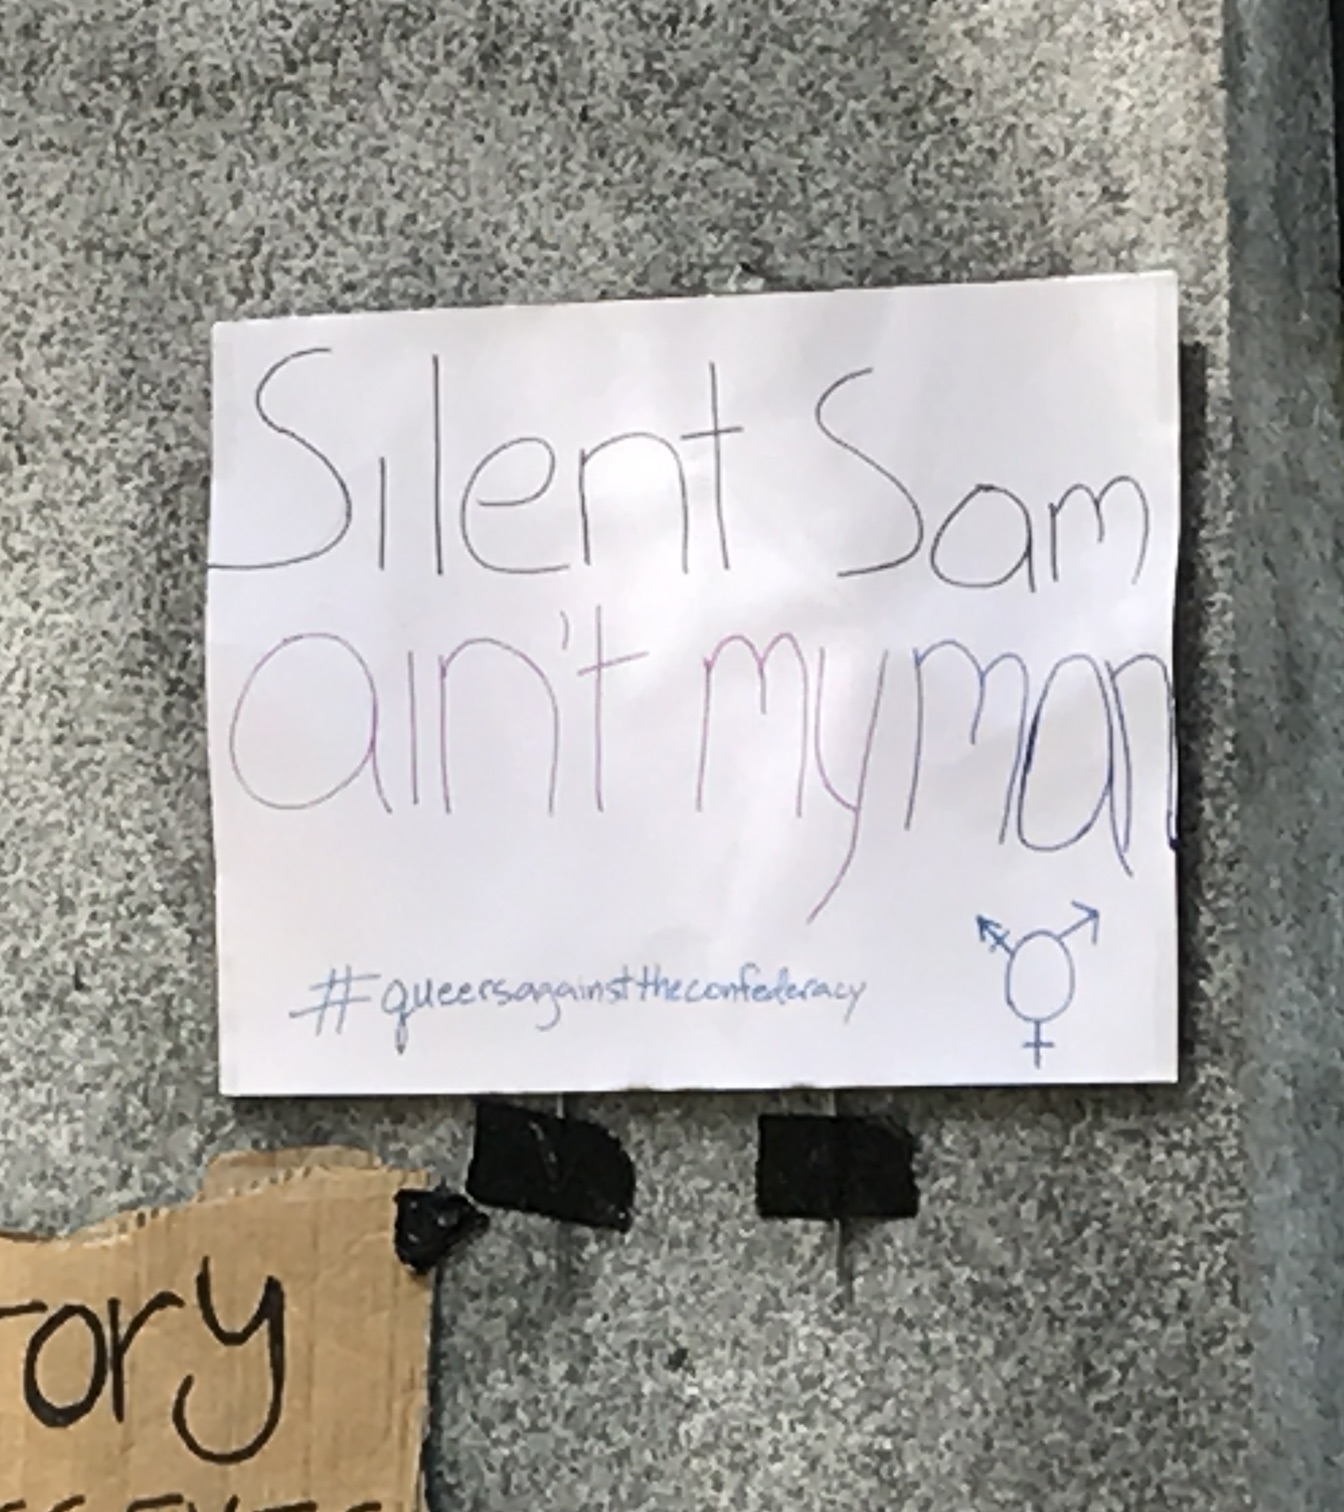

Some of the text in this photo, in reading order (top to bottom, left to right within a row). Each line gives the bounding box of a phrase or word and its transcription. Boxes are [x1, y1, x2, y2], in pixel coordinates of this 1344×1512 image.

[206, 346, 1150, 593] Silent Sam
[229, 604, 1180, 924] ain't my man
[288, 963, 868, 1056] #queersagainsttheconfederacy
